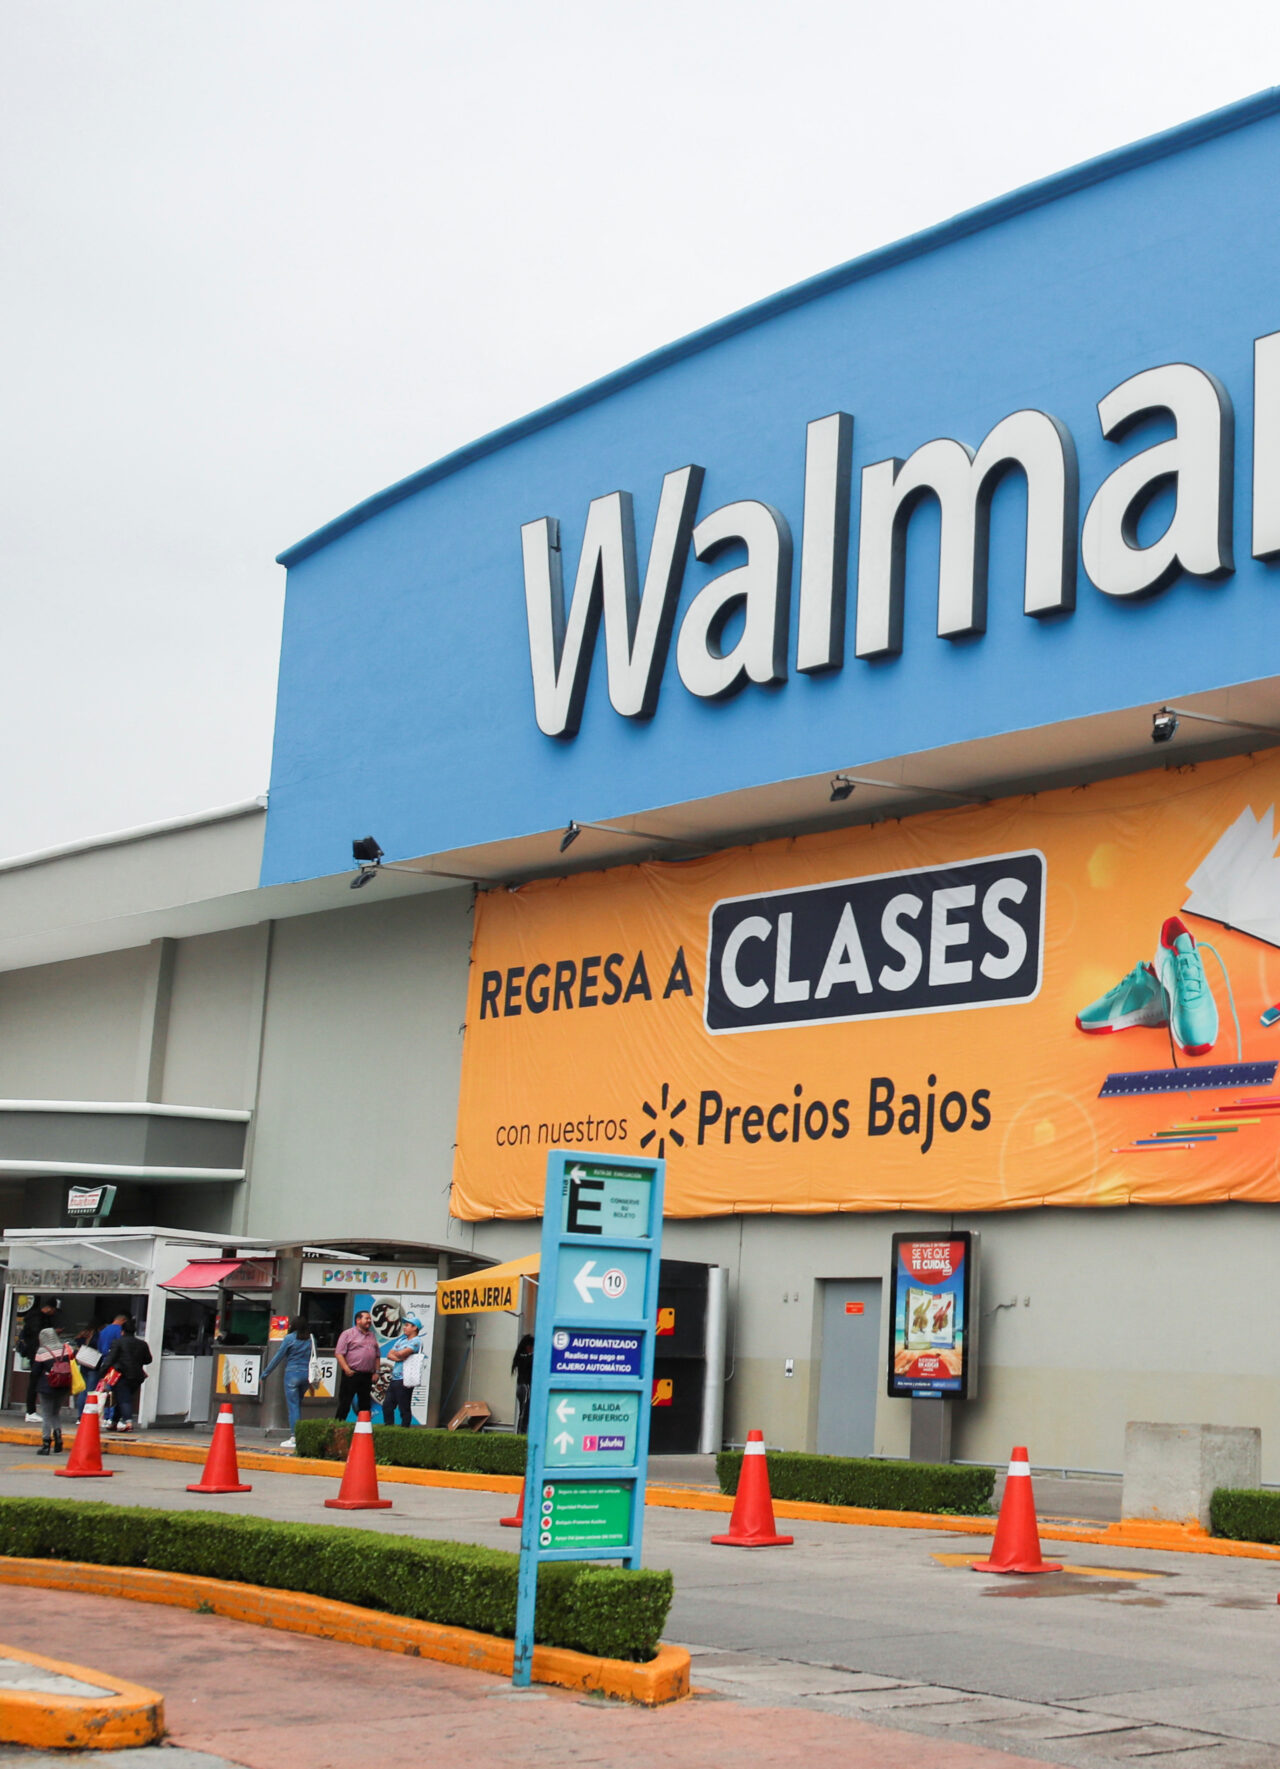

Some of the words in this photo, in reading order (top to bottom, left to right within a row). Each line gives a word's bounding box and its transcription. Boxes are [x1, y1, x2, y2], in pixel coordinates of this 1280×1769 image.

[720, 876, 1028, 1009] CLASES
[479, 950, 652, 1020] REGRESA
[662, 945, 693, 999] A
[696, 1084, 850, 1146] Precios
[867, 1073, 992, 1154] Bajos
[496, 1122, 533, 1147] con
[537, 1114, 628, 1145] nuestros
[567, 1178, 604, 1234] E
[322, 1268, 388, 1286] postres
[607, 1274, 622, 1289] 10
[442, 1286, 512, 1310] CERRAJERIA
[572, 1338, 638, 1349] AUTOMATIZADO
[244, 1367, 253, 1384] 15
[321, 1366, 333, 1379] 15
[556, 1362, 586, 1370] CAJERO
[586, 1362, 632, 1372] AUTOMÁTICO
[592, 1403, 621, 1411] SALIDA
[582, 1414, 630, 1422] PERIFERICO
